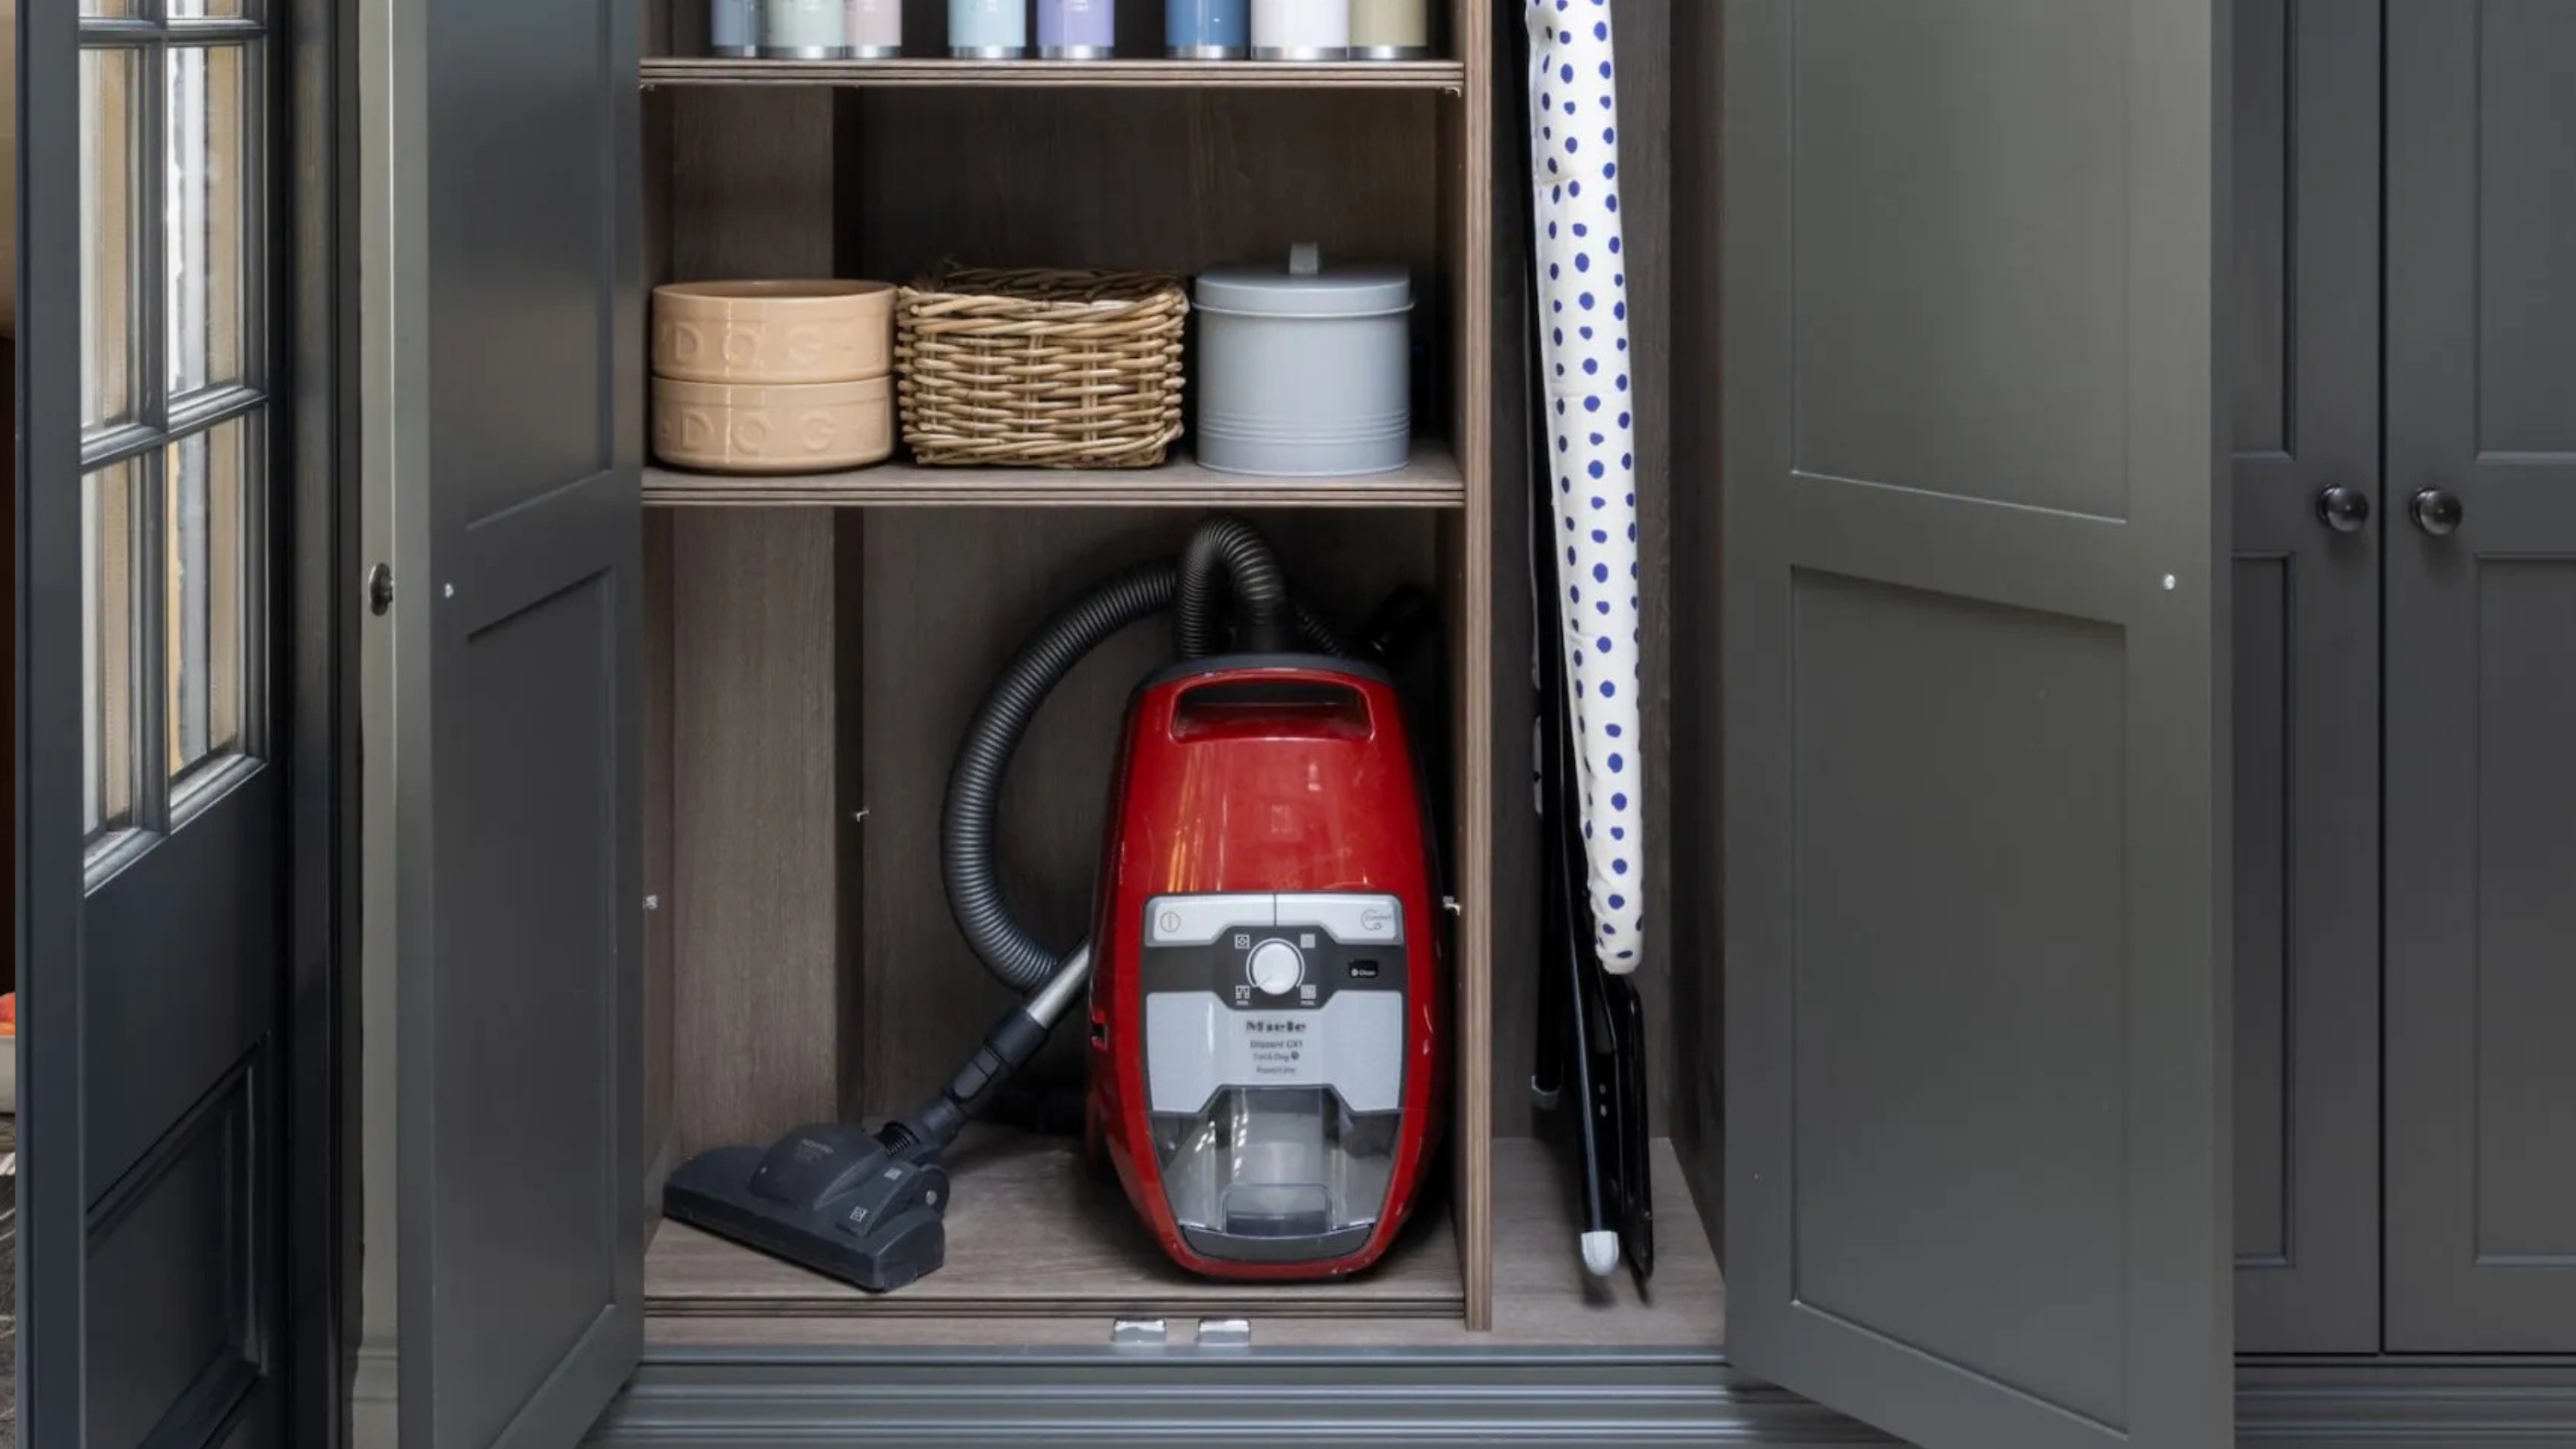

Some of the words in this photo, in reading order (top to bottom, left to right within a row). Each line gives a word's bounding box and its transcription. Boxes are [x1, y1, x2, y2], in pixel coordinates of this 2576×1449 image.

[675, 323, 824, 367] DOG
[681, 408, 835, 455] DOG
[1246, 1021, 1307, 1032] Miele
